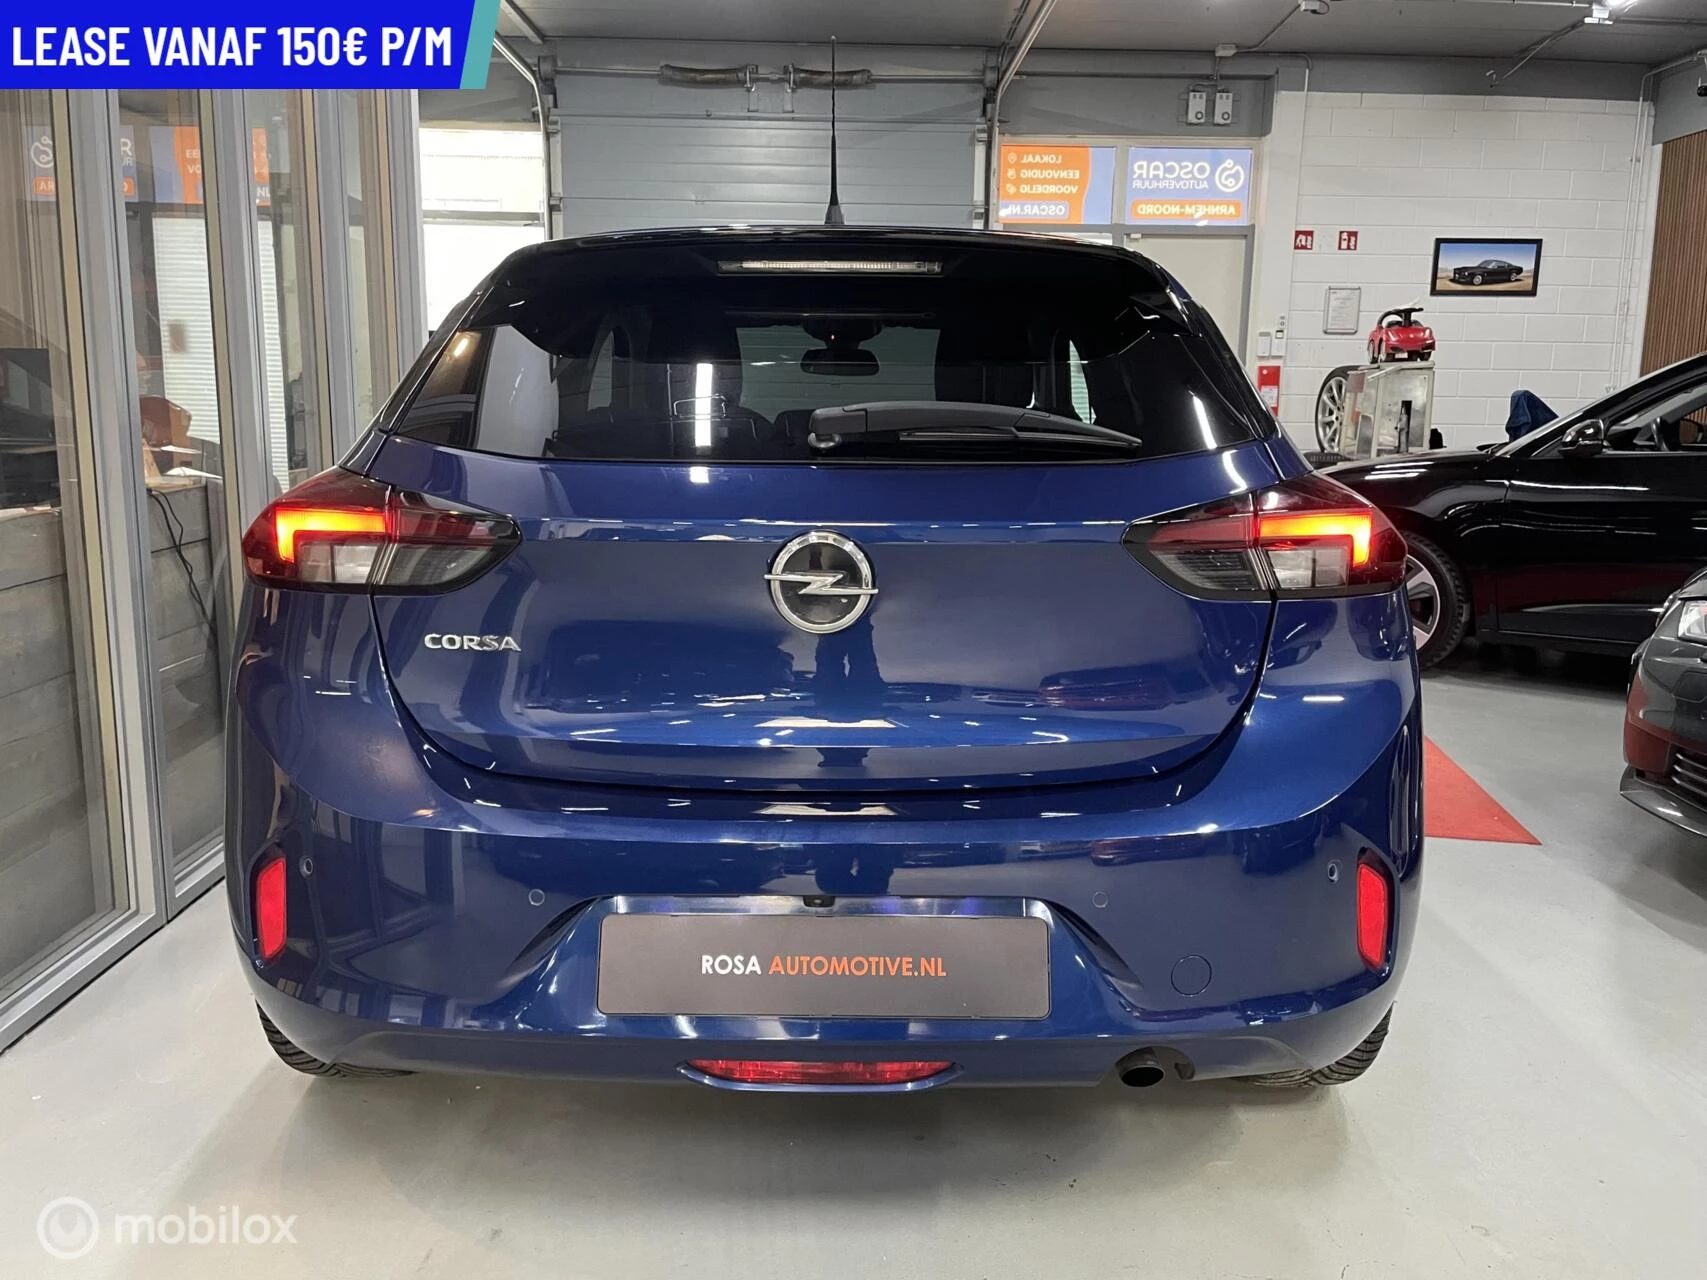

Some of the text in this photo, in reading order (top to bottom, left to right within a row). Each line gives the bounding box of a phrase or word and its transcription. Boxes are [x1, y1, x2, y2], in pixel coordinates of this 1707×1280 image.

[424, 633, 522, 652] CORSA
[701, 955, 947, 977] ROSA AUTOMOTIVE.NL
